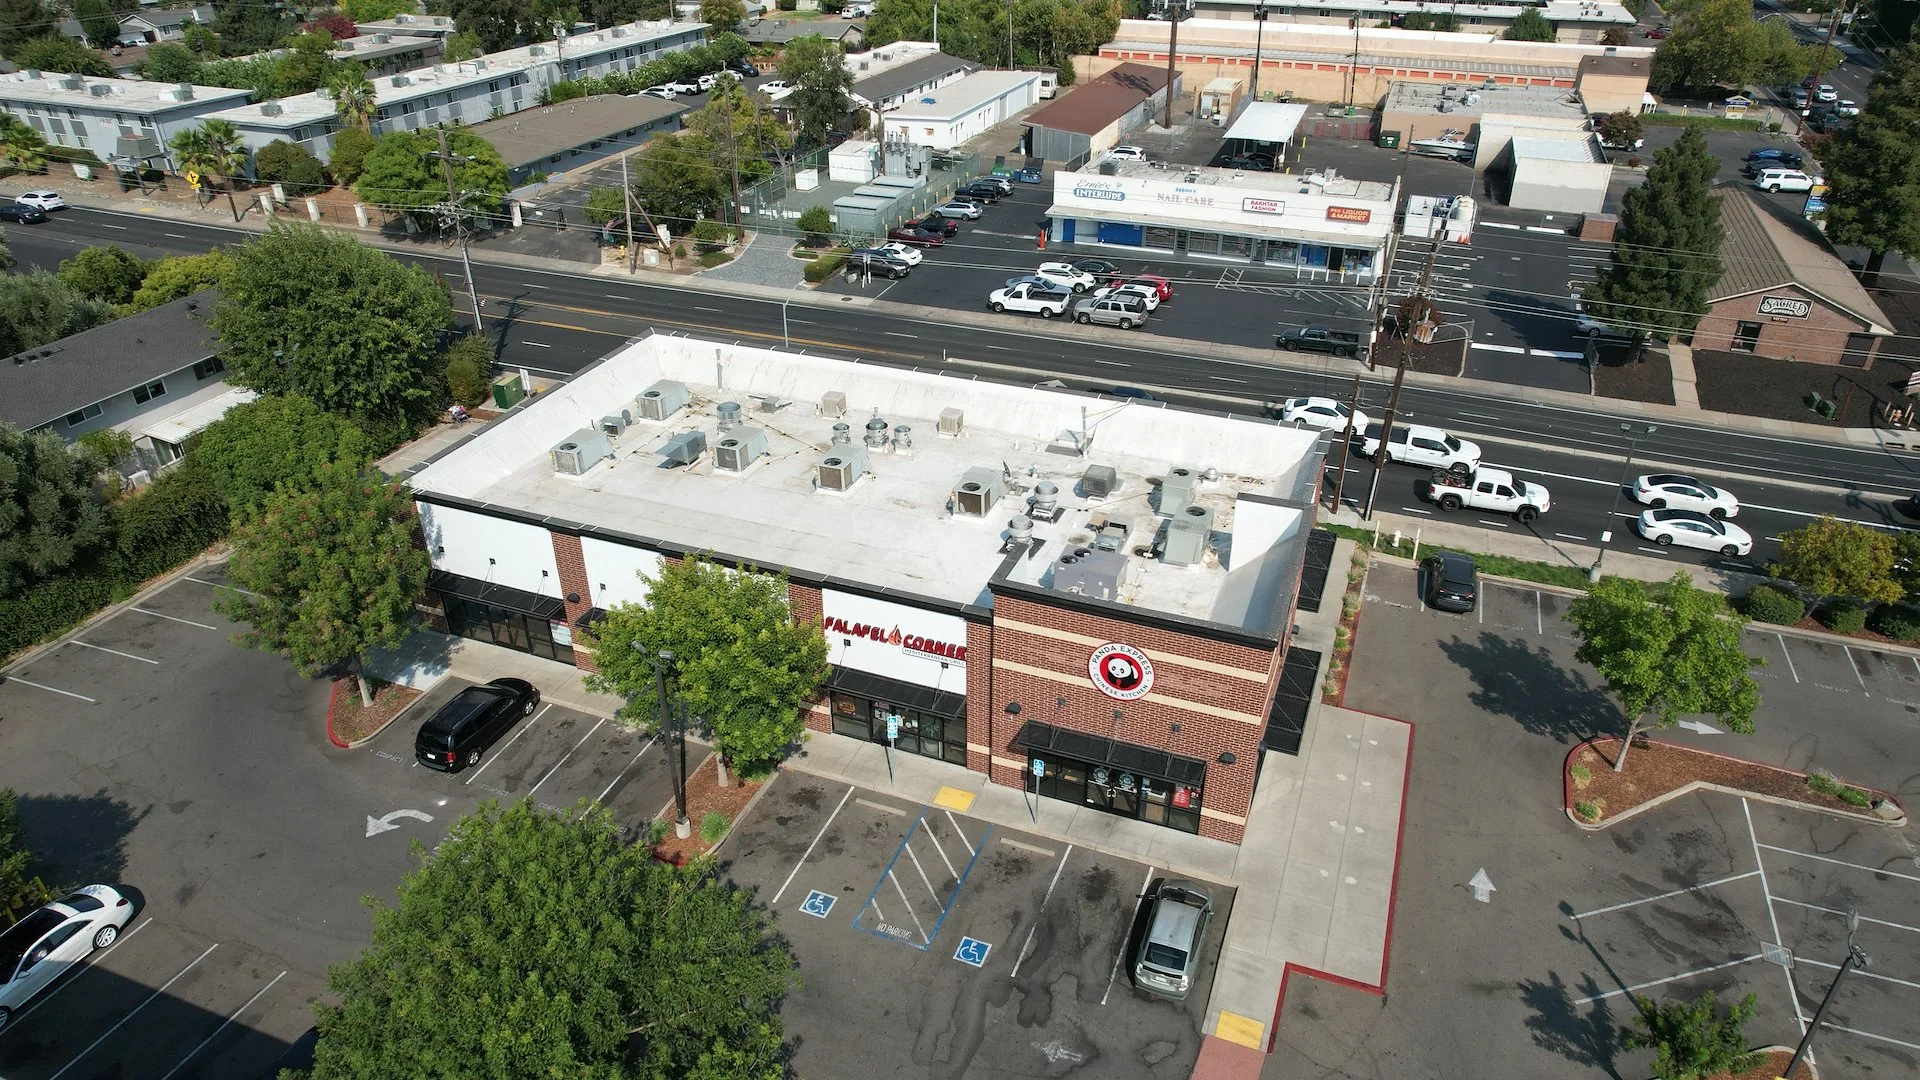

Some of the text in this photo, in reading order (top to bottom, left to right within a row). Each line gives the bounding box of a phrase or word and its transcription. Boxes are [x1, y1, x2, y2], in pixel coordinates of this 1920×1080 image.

[1076, 188, 1123, 201] INTERLUDE
[1157, 193, 1214, 206] NAIL CARE
[1337, 213, 1367, 222] MARKET
[1342, 208, 1369, 217] LIQUOR
[1761, 298, 1809, 316] SACRED
[824, 616, 967, 661] FALAFEL CORNER
[905, 648, 949, 662] MEDITERRANEAN
[1092, 645, 1152, 675] PANDA EXPRESS
[1093, 673, 1148, 698] CHINESE KITCHEN
[876, 922, 912, 940] NO PARKING
